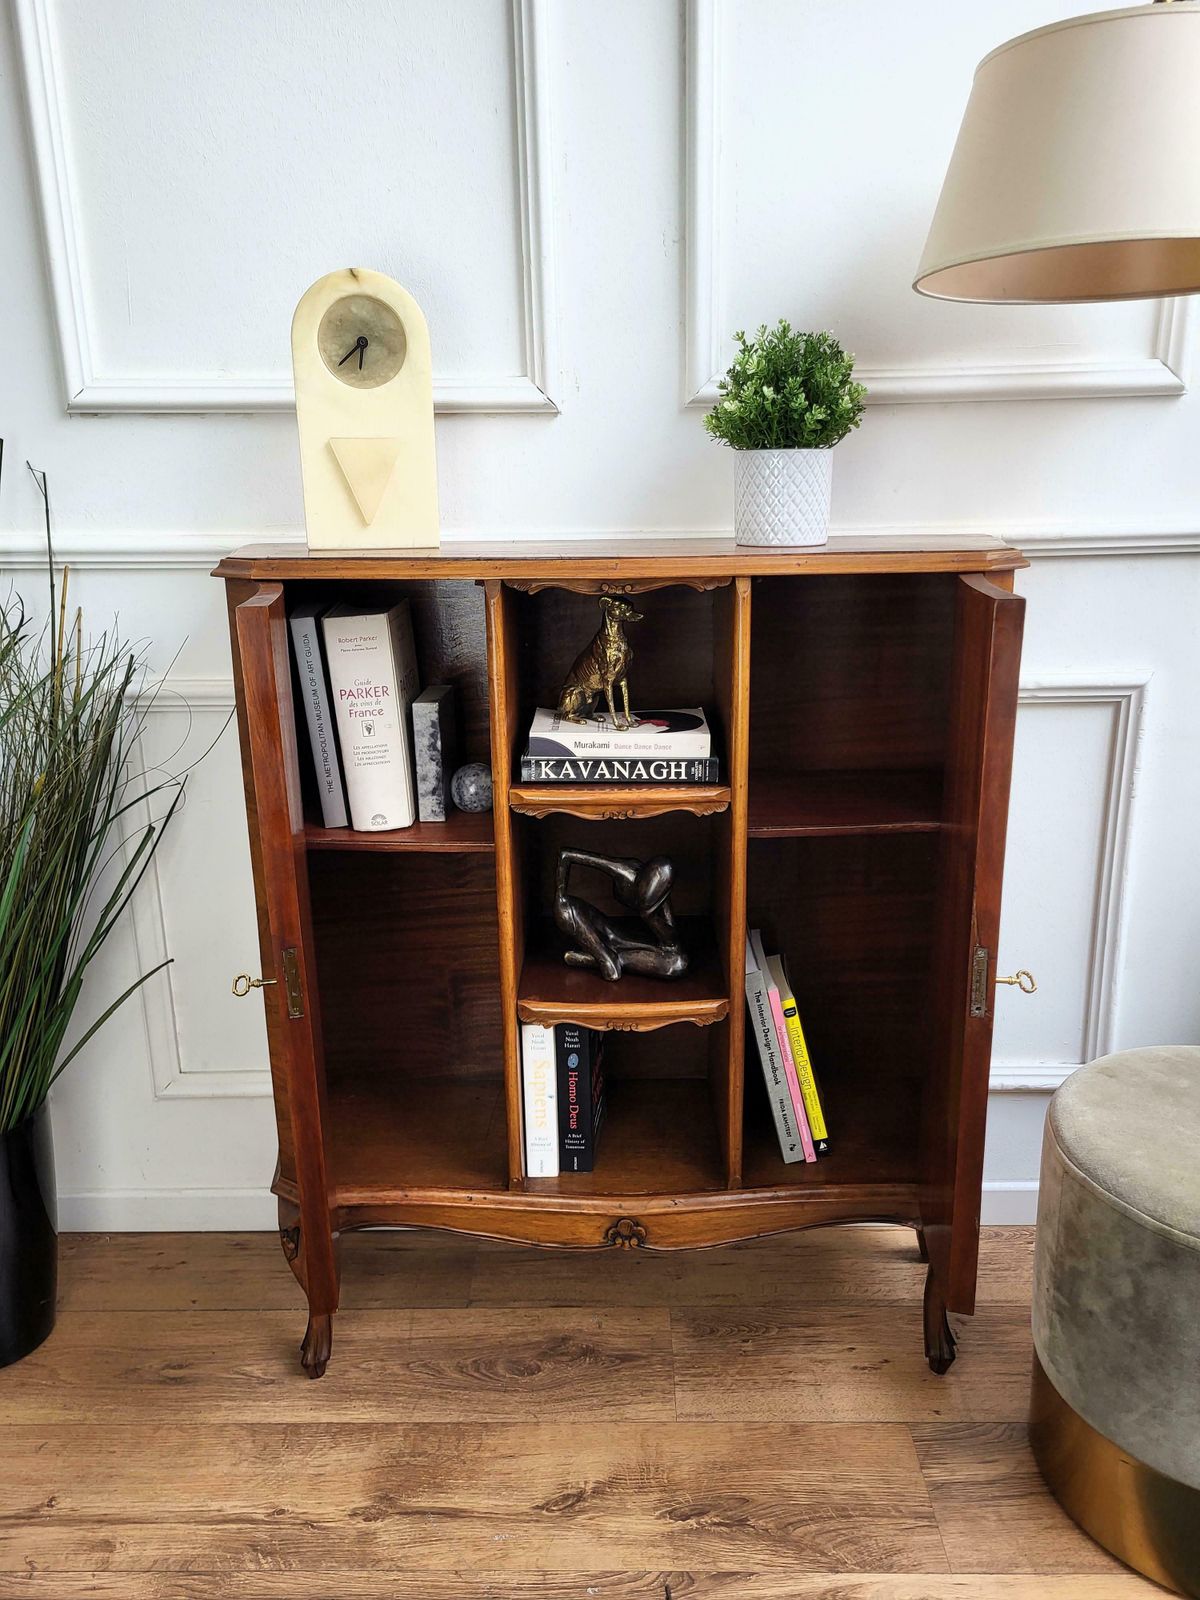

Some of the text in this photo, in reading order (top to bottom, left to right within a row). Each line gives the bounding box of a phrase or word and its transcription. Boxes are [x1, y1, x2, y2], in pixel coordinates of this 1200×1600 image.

[340, 685, 390, 700] PARKER
[354, 678, 372, 686] Guide
[302, 633, 334, 794] THE METROPOLITAN MUSEUM OF ART GUIDA
[349, 708, 384, 718] France
[539, 761, 688, 779] KAVANAGH
[757, 1004, 766, 1028] Interior
[762, 1028, 772, 1050] Design
[768, 1052, 781, 1086] Handbook
[790, 1026, 804, 1058] Interior
[799, 1060, 812, 1090] Design
[528, 1060, 551, 1129] Sapiens
[569, 1072, 579, 1129] Homo Deus
[782, 1113, 792, 1138] RAMSTEDT
